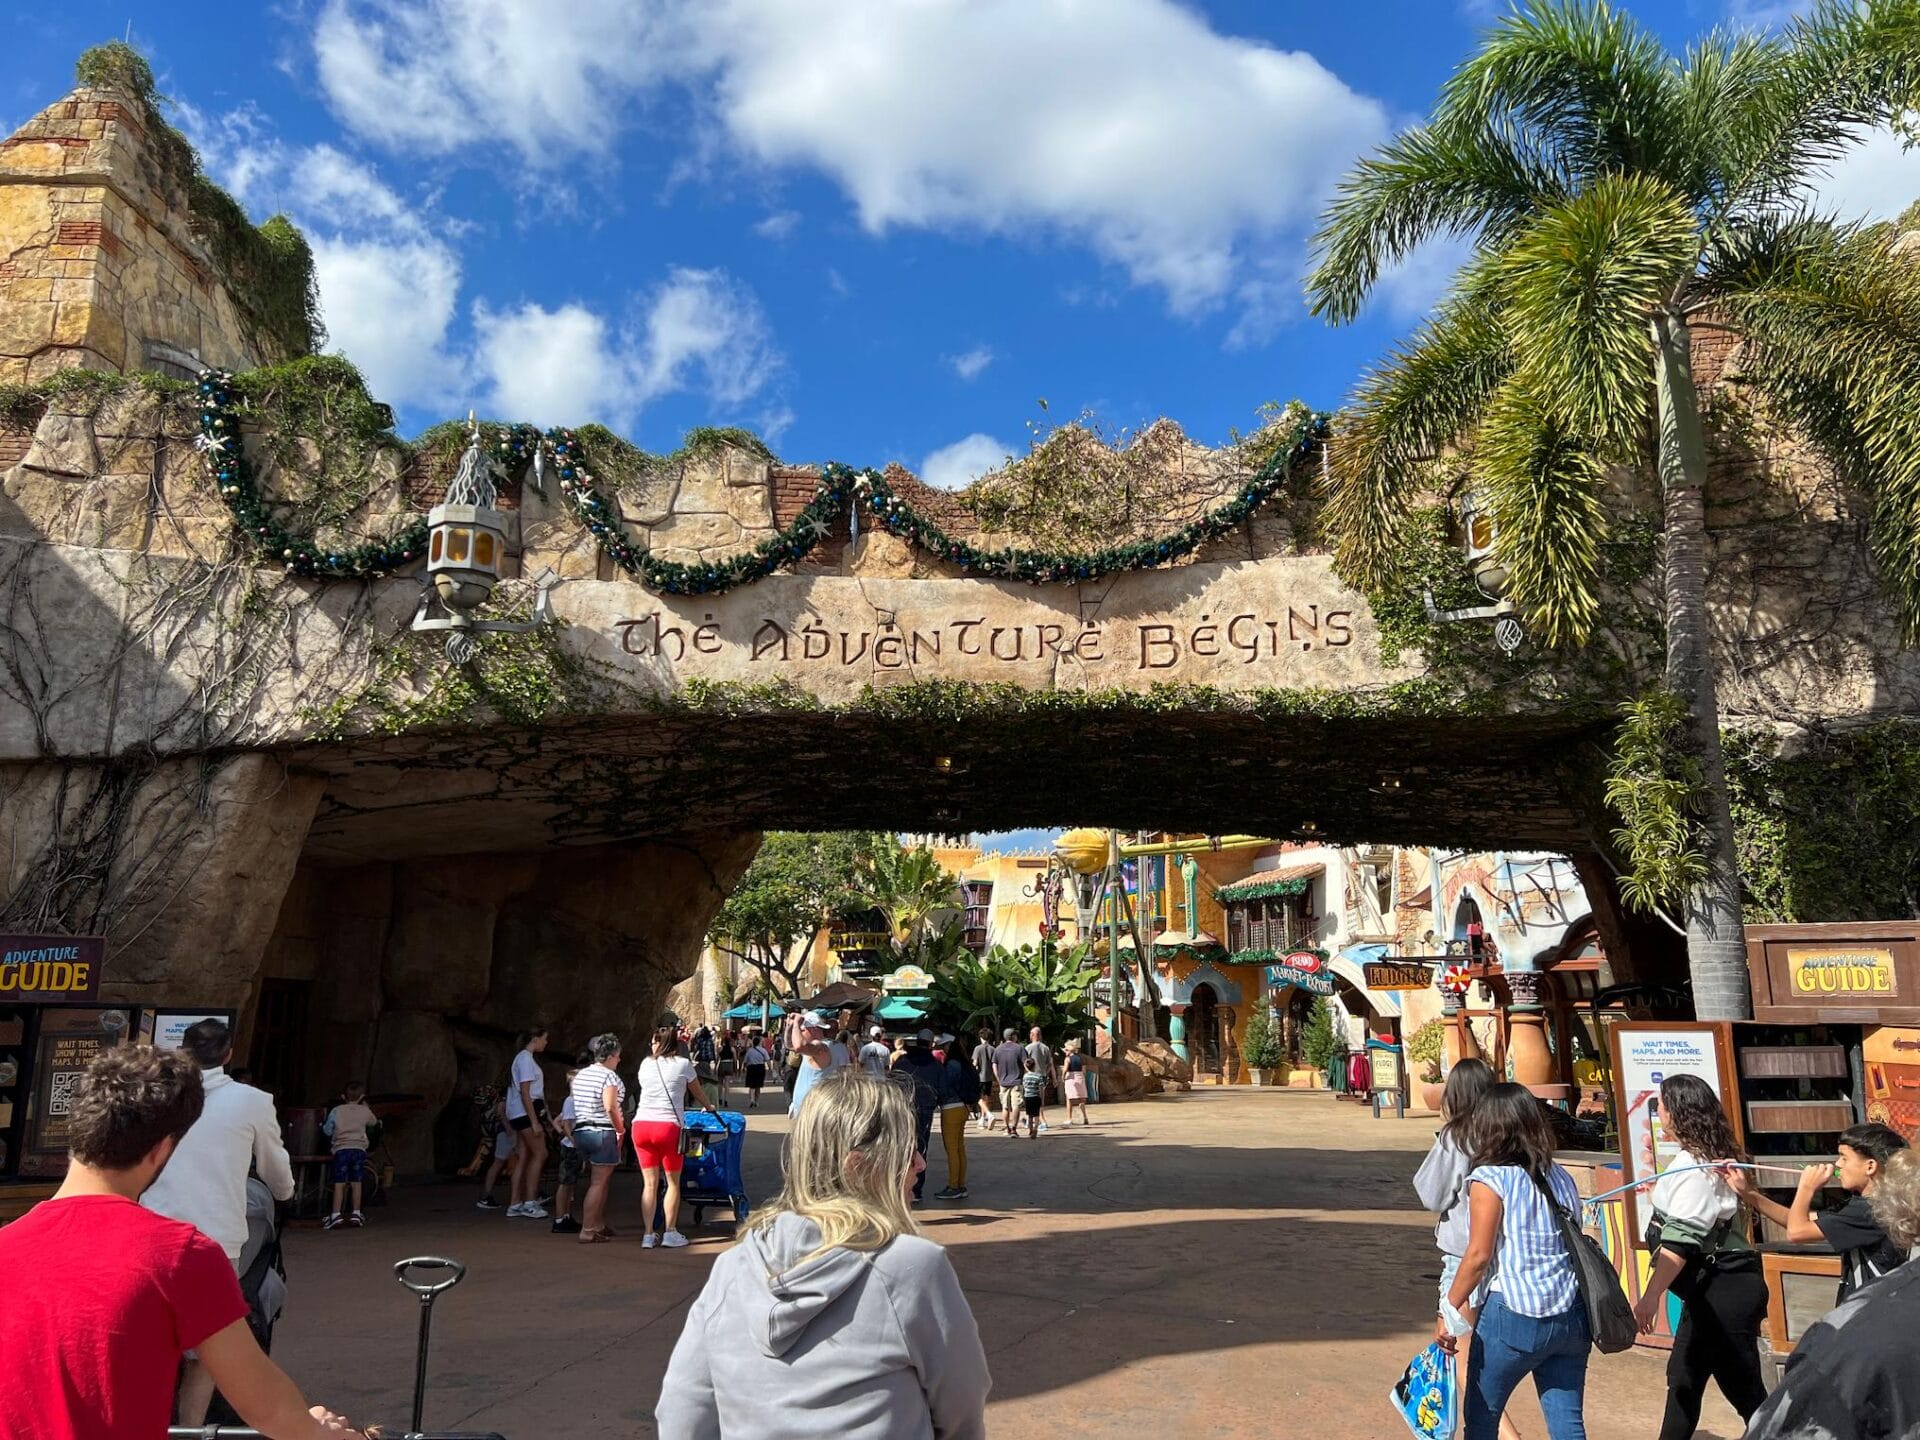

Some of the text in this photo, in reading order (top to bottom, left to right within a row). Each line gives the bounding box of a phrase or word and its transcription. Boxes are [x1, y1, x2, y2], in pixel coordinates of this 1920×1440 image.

[3, 946, 79, 964] ADVENTURE
[1291, 955, 1314, 967] ISLAND
[1802, 954, 1877, 968] ADVENTURE
[0, 962, 90, 991] GUIDE
[1271, 966, 1333, 994] MARKET EXPORT
[1369, 967, 1414, 985] FUDGE
[1416, 969, 1428, 984] &
[1796, 966, 1891, 992] GUIDE
[55, 1049, 76, 1057] SHOW
[57, 1040, 76, 1048] WAIT
